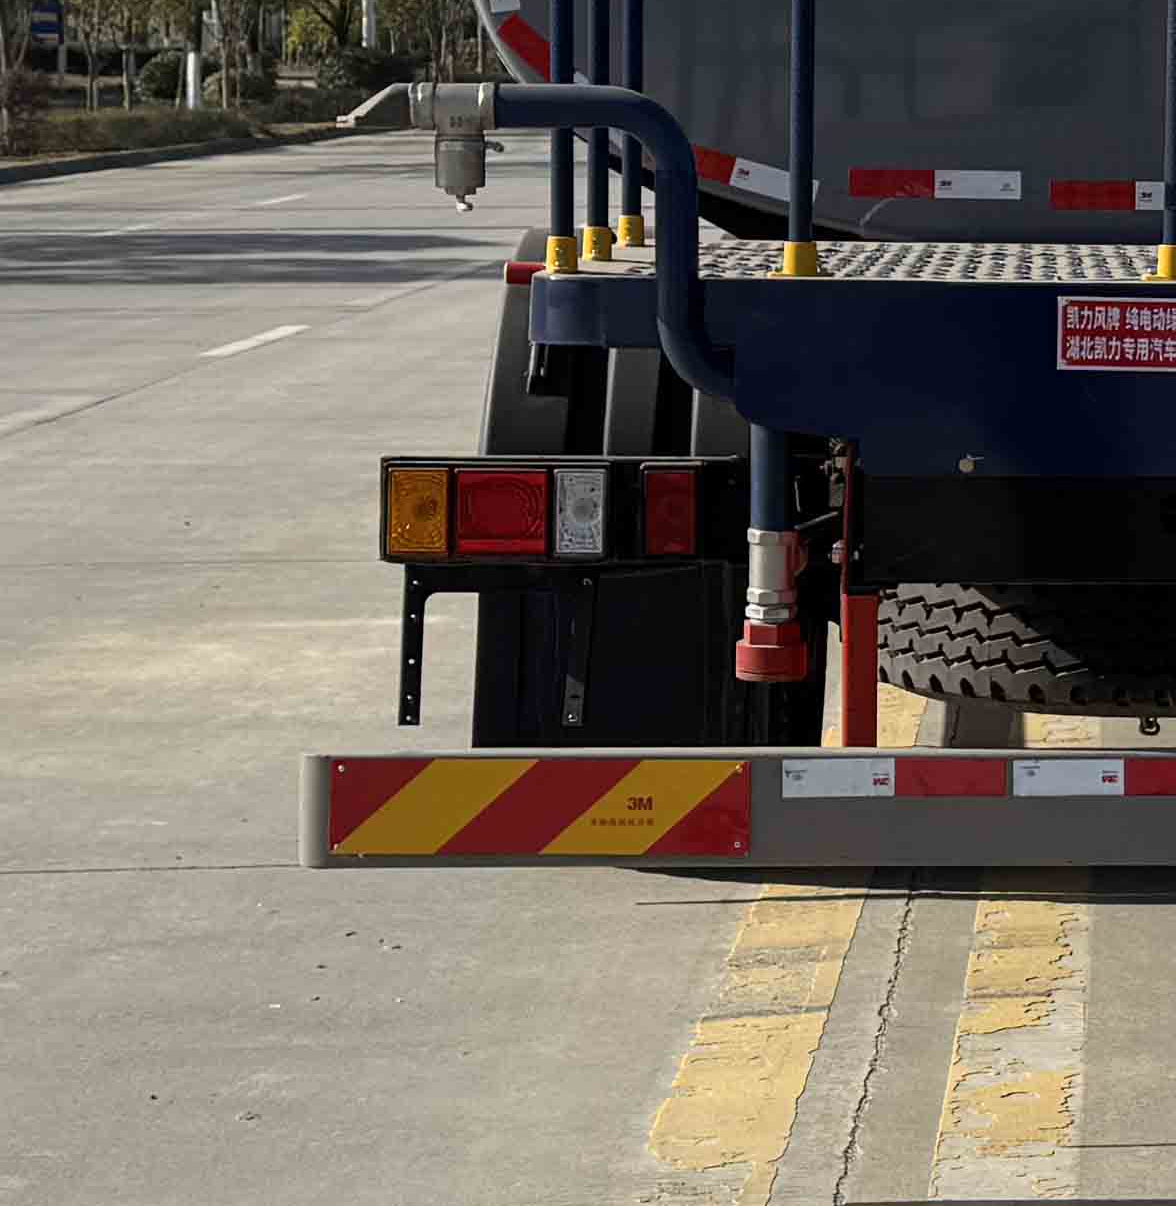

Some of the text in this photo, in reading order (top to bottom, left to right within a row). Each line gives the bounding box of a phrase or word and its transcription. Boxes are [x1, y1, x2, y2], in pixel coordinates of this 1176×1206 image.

[1066, 305, 1121, 331] 凯力风牌
[627, 796, 653, 811] 3M
